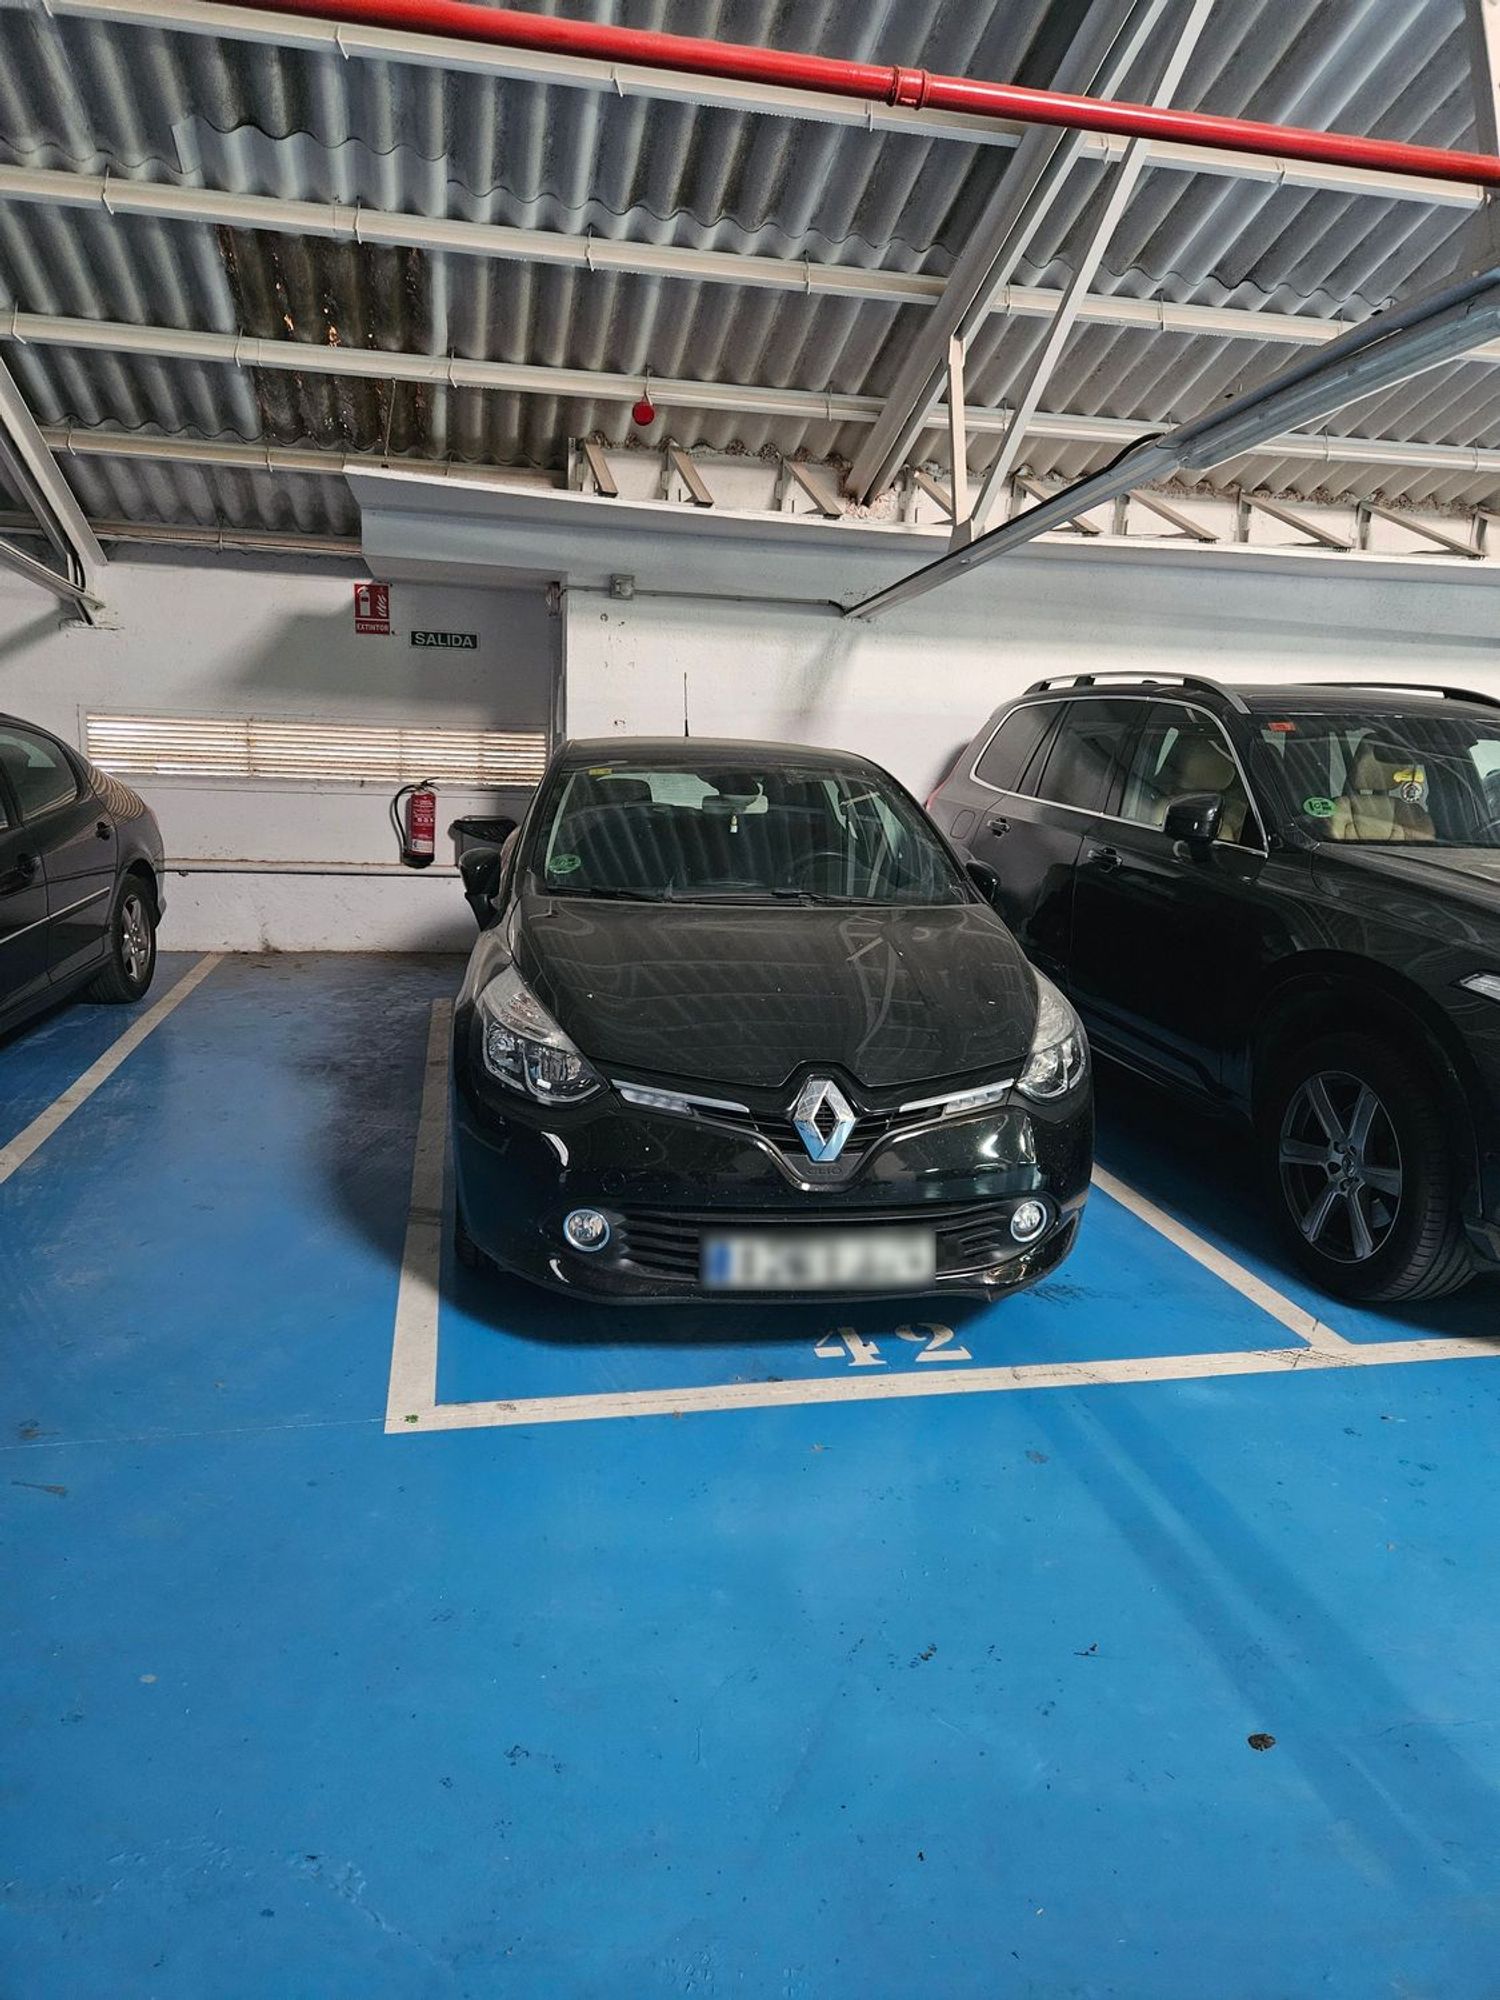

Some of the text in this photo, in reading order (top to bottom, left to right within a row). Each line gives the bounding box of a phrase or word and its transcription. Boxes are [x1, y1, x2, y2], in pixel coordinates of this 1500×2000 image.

[356, 622, 389, 632] EXTINTOR
[415, 632, 474, 648] SALIDA
[806, 1166, 842, 1176] CLIO
[813, 1322, 972, 1367] 42
